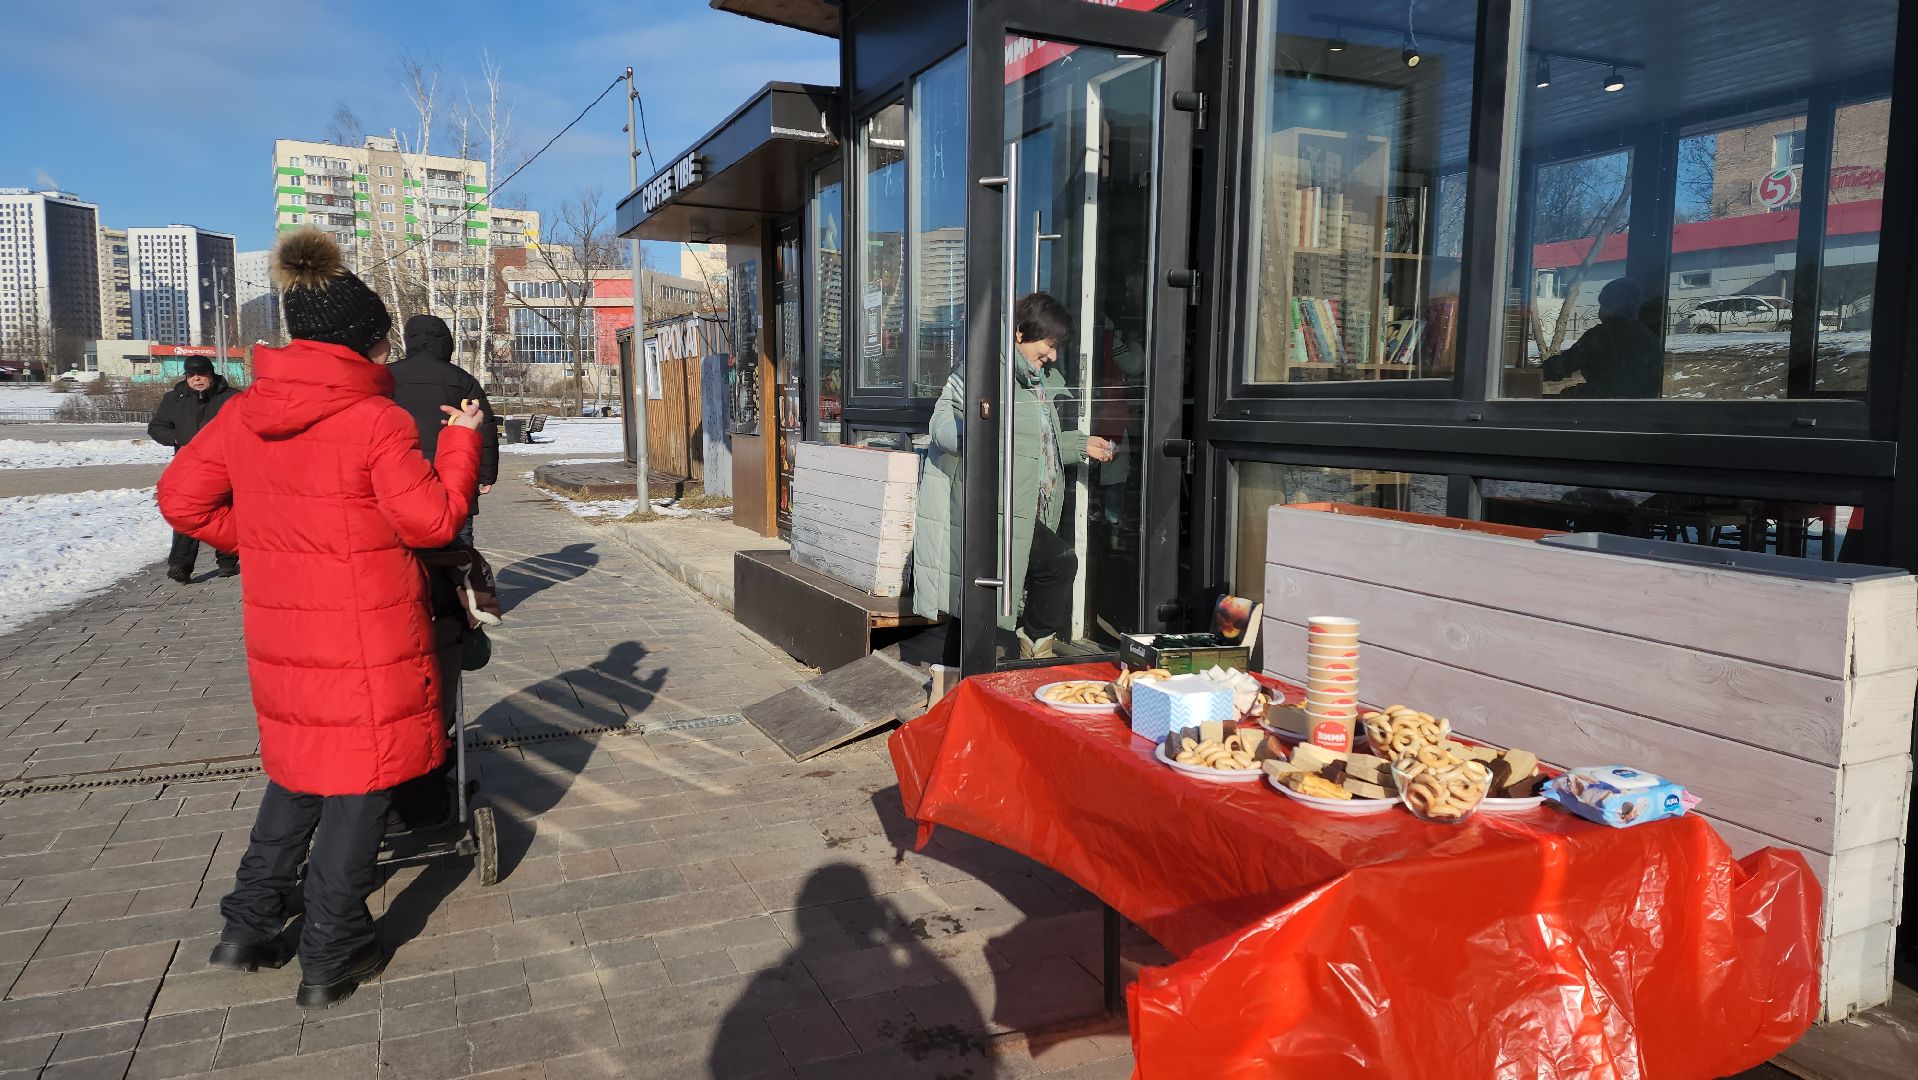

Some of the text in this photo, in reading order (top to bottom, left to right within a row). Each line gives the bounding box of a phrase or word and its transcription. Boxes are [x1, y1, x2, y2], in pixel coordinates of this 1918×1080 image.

[642, 151, 697, 213] COFFEE VIBE
[657, 318, 699, 362] ПРОКАТ
